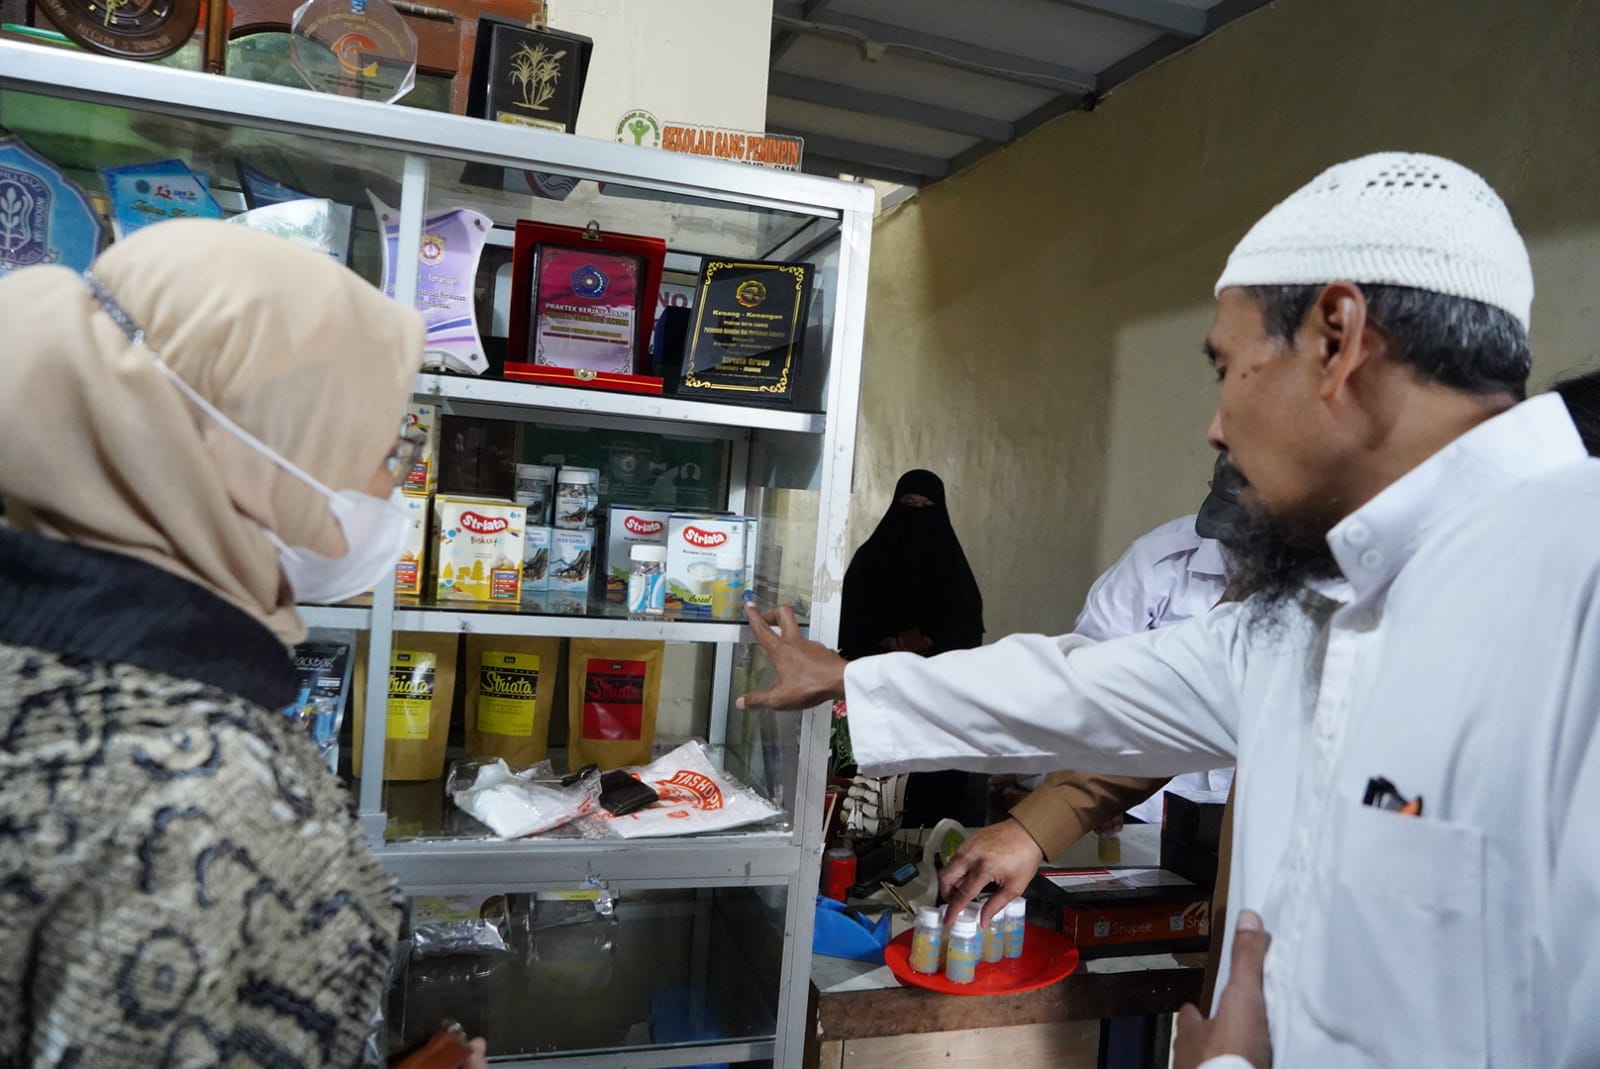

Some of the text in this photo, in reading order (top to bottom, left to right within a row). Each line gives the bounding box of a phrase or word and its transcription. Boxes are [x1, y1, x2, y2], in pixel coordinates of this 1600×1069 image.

[661, 126, 714, 156] SEKOLAH
[714, 131, 744, 159] SANG
[746, 136, 800, 166] PEMIMPIN
[545, 302, 577, 313] PRAKTEK
[578, 306, 599, 315] KERJA
[712, 309, 740, 318] Kenang
[746, 311, 784, 320] Kenangan
[462, 514, 506, 531] Striata
[626, 518, 661, 533] Striata
[685, 529, 724, 545] Striata
[388, 674, 431, 694] triata
[481, 671, 533, 694] Striata
[590, 677, 640, 699] Striata
[1111, 922, 1152, 937] Shopee
